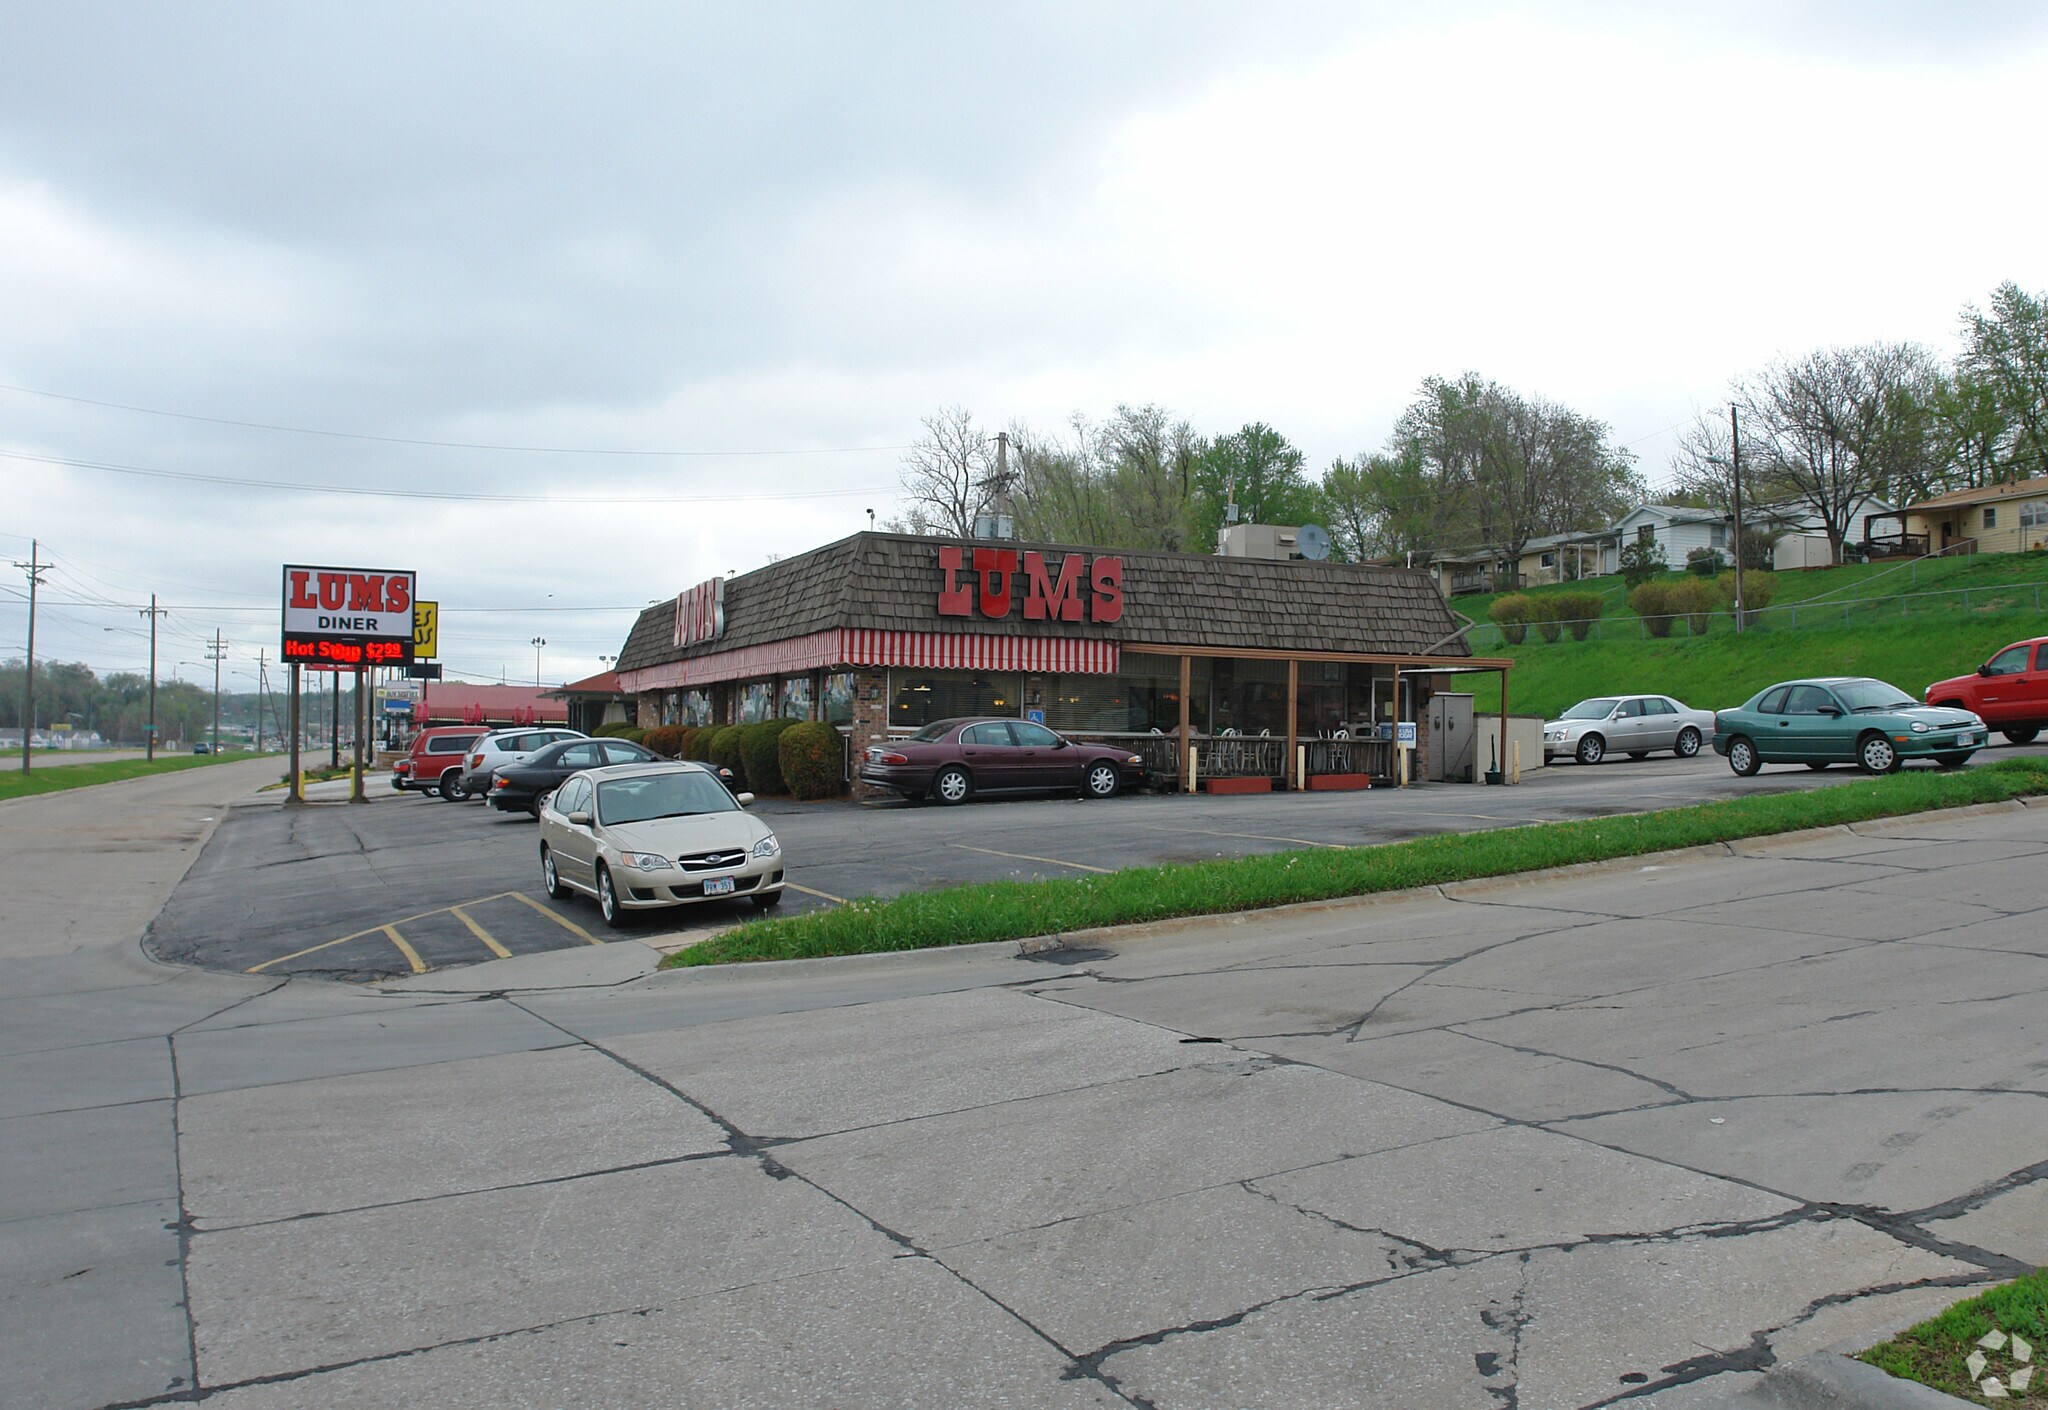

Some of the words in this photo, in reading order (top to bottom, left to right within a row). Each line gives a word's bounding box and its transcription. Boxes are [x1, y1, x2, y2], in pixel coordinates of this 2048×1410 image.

[290, 571, 410, 613] LUMS
[938, 546, 1124, 623] LUMS
[318, 616, 378, 631] DINER
[286, 640, 315, 656] Hot
